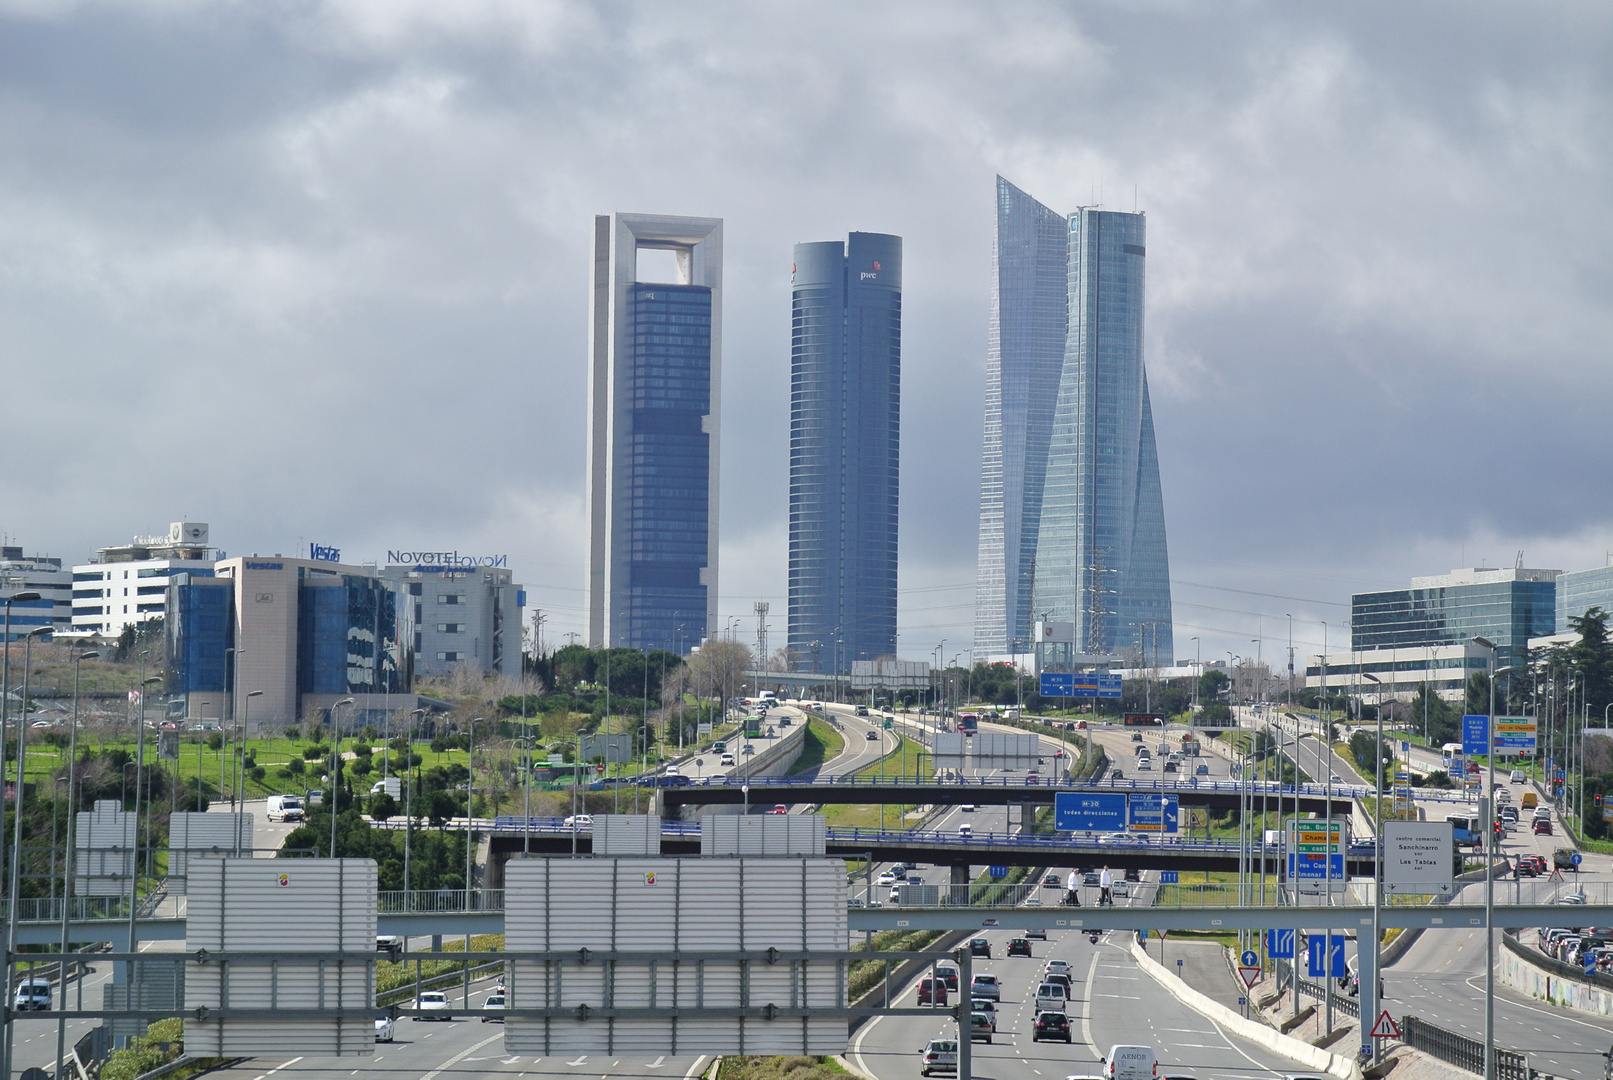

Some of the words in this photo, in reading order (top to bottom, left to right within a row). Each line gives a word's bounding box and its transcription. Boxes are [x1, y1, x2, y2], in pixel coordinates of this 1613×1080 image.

[860, 271, 877, 280] pwc
[310, 542, 340, 562] Vestas
[388, 550, 463, 564] NOVOTEL
[246, 562, 284, 570] Vestas
